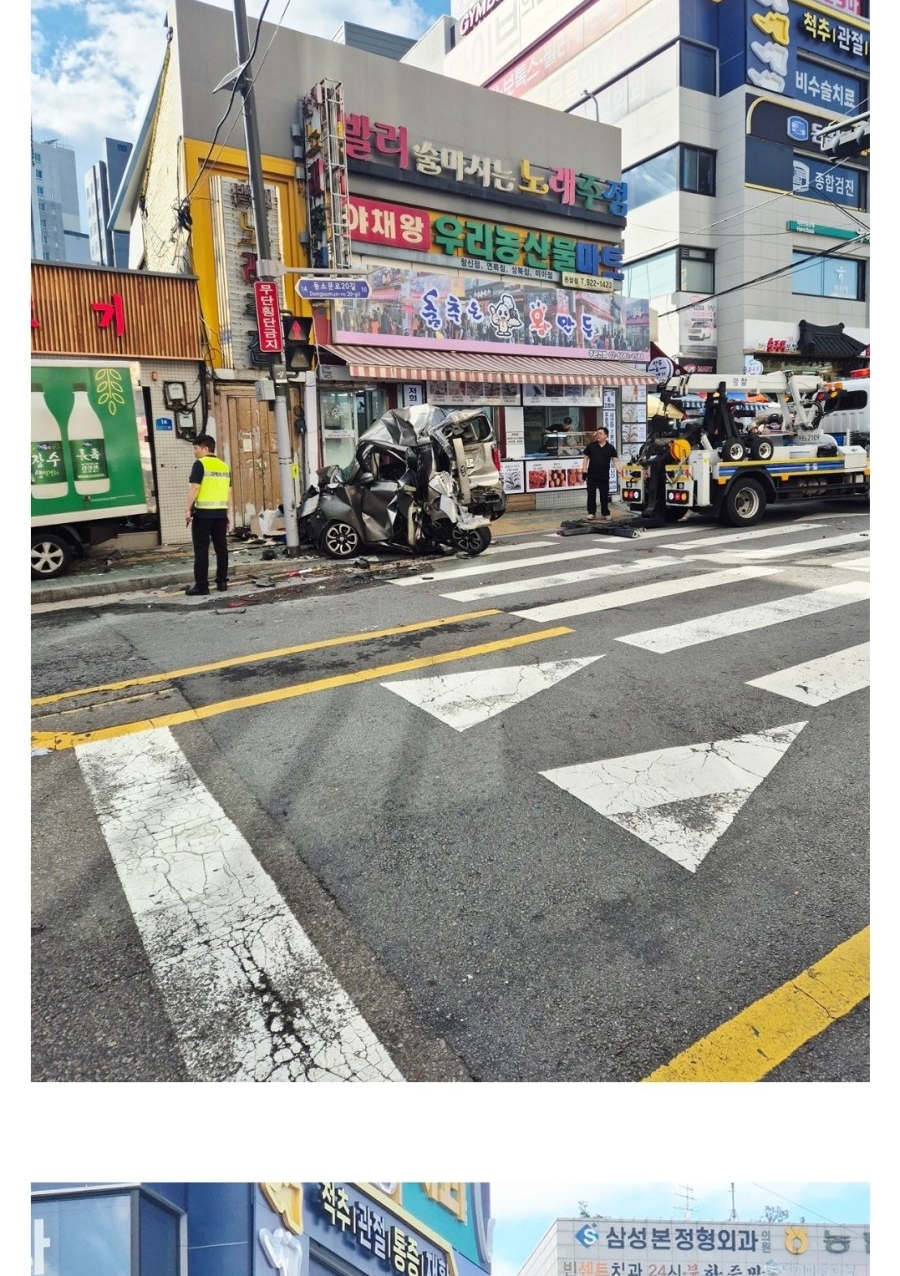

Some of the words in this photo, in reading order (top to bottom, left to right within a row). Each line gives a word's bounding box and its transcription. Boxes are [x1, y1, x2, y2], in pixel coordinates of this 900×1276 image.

[803, 12, 831, 42] 척추
[837, 25, 864, 57] 관절
[795, 71, 856, 109] 비수술치료
[412, 141, 516, 192] 술마시는
[517, 158, 628, 217] 노래주점
[815, 171, 854, 198] 종합검진
[343, 203, 425, 244] 야채왕
[432, 215, 625, 281] 우리농산물마트
[313, 282, 356, 291] 동소문로20길
[91, 292, 125, 337] 기
[259, 284, 278, 349] 무단횡단금지
[529, 298, 594, 340] 왕만두
[408, 387, 417, 403] 저희
[358, 1201, 386, 1261] 관절
[606, 1226, 758, 1253] 삼성본정형외과
[824, 1229, 851, 1255] 농
